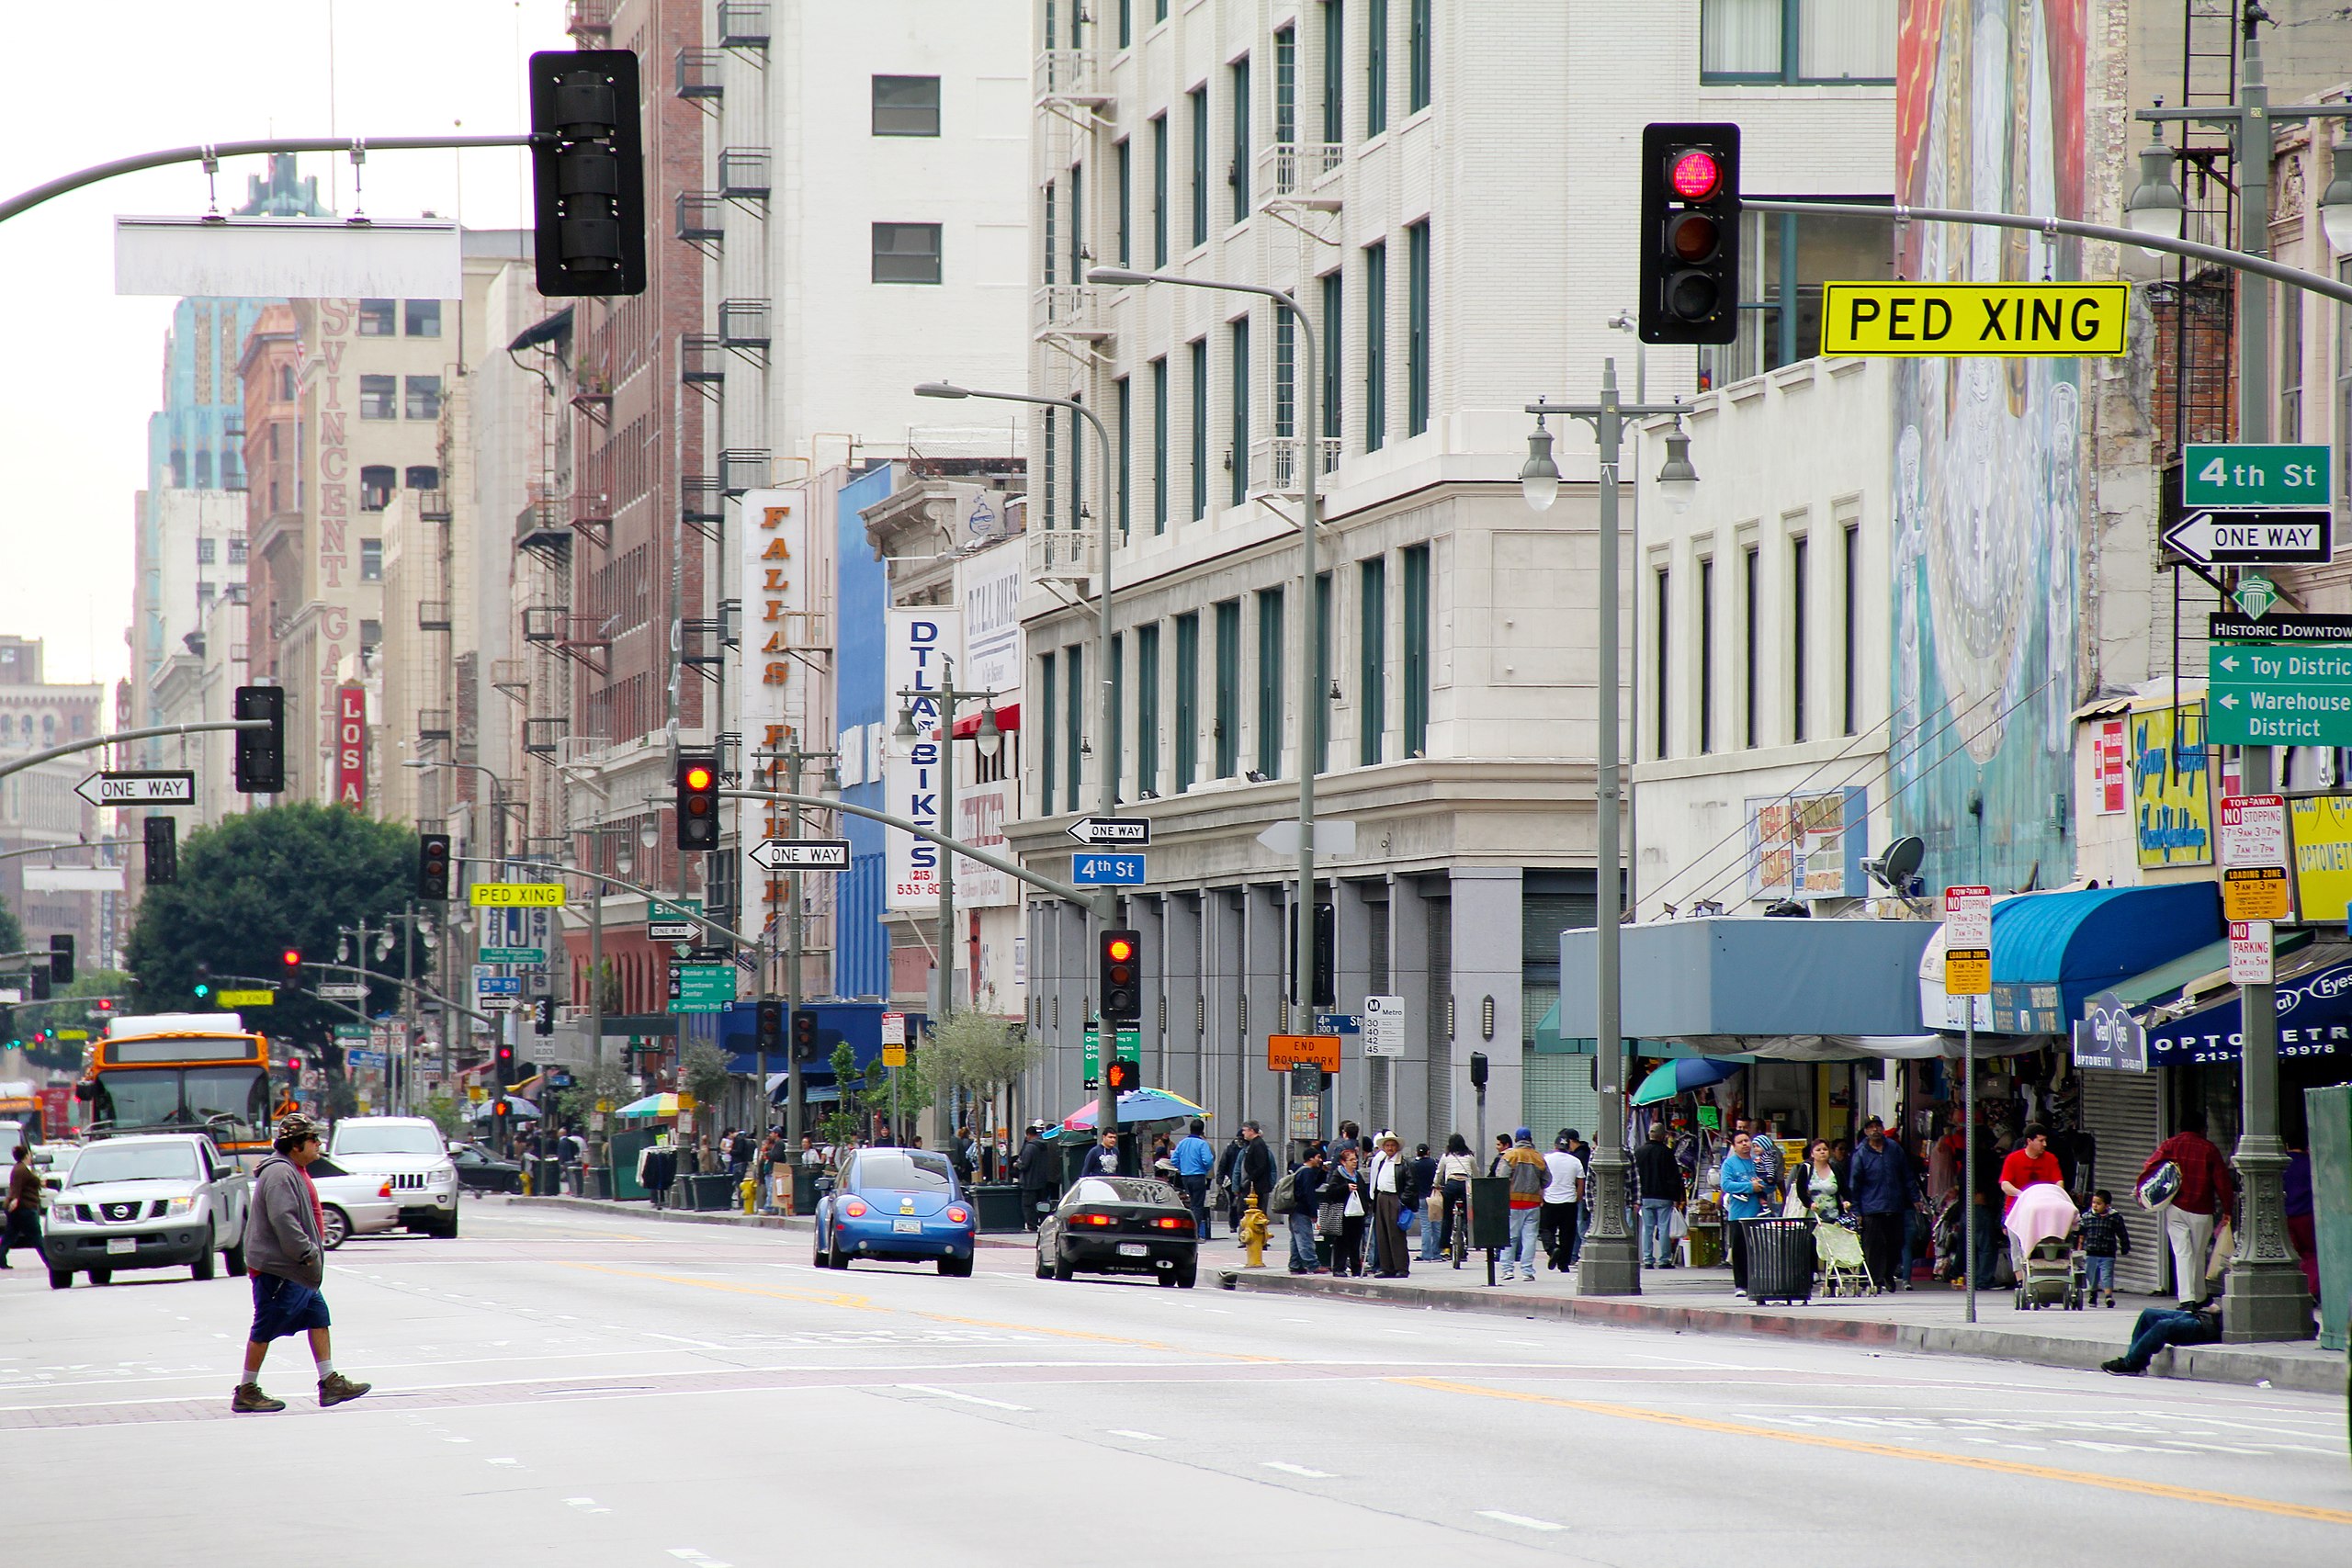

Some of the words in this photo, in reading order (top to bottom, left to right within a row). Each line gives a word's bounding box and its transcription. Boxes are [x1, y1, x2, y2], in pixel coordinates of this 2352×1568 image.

[1850, 298, 1952, 341] PED
[1979, 298, 2100, 342] XING
[2199, 457, 2265, 487] 4th
[2283, 464, 2317, 487] St
[2215, 528, 2259, 547] ONE
[2267, 528, 2312, 547] WAY
[2214, 623, 2278, 637] HISTORIC
[910, 622, 938, 717] DTLA
[2251, 657, 2282, 679] Toy
[2250, 692, 2351, 711] Warehouse
[343, 698, 361, 770] LOS
[2250, 717, 2321, 737] District
[102, 780, 136, 797] ONE
[147, 780, 185, 797] WAY
[911, 744, 938, 868] BIKES
[2224, 808, 2241, 824] NO
[2244, 810, 2281, 823] STOPPING
[1091, 827, 1114, 836] ONE
[1118, 827, 1141, 836] WAY
[772, 848, 800, 862] ONE
[810, 848, 842, 862] WAY
[2299, 842, 2352, 872] OPTOMET
[1081, 860, 1112, 879] 4th
[1115, 862, 1135, 877] St
[2229, 871, 2260, 879] LOADING
[2262, 869, 2282, 878] ZONE
[480, 889, 511, 901] PED
[519, 889, 556, 902] XING
[1948, 897, 1960, 910] NO
[1962, 899, 1988, 909] STOPPING
[2233, 924, 2247, 938] NO
[2233, 942, 2268, 953] PARKING
[481, 980, 502, 991] 5th
[504, 981, 516, 990] St
[2321, 976, 2352, 995] Eyes
[1318, 1016, 1330, 1025] 4th
[1350, 1016, 1361, 1026] St
[1295, 1042, 1315, 1051] END
[2154, 1026, 2350, 1052] OPTOETR
[1274, 1055, 1300, 1065] ROAD
[1306, 1056, 1334, 1066] WORK
[2077, 1055, 2111, 1066] OPTOMETRY
